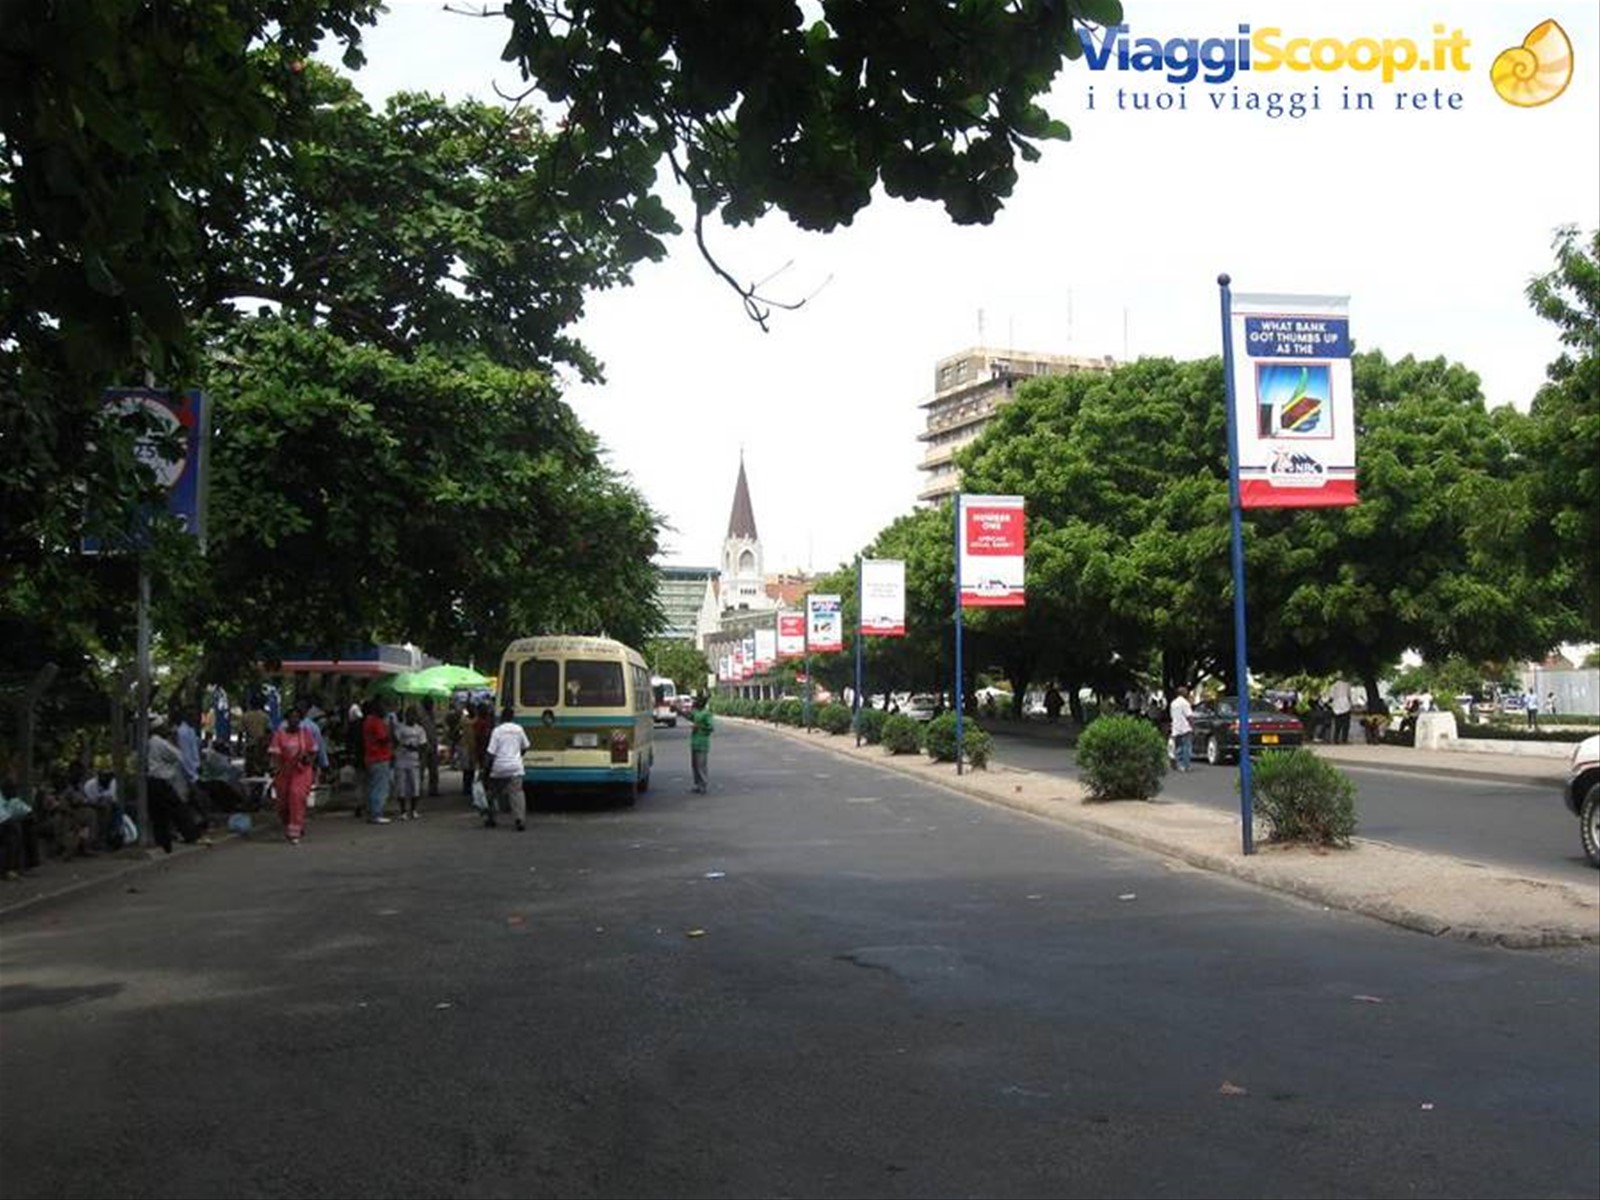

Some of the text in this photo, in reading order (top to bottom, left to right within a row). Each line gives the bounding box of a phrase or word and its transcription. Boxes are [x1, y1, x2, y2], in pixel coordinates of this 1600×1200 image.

[1261, 321, 1327, 332] WHAT BANK
[1249, 332, 1338, 344] GOT THUMBS UP
[1276, 344, 1313, 355] AS THE
